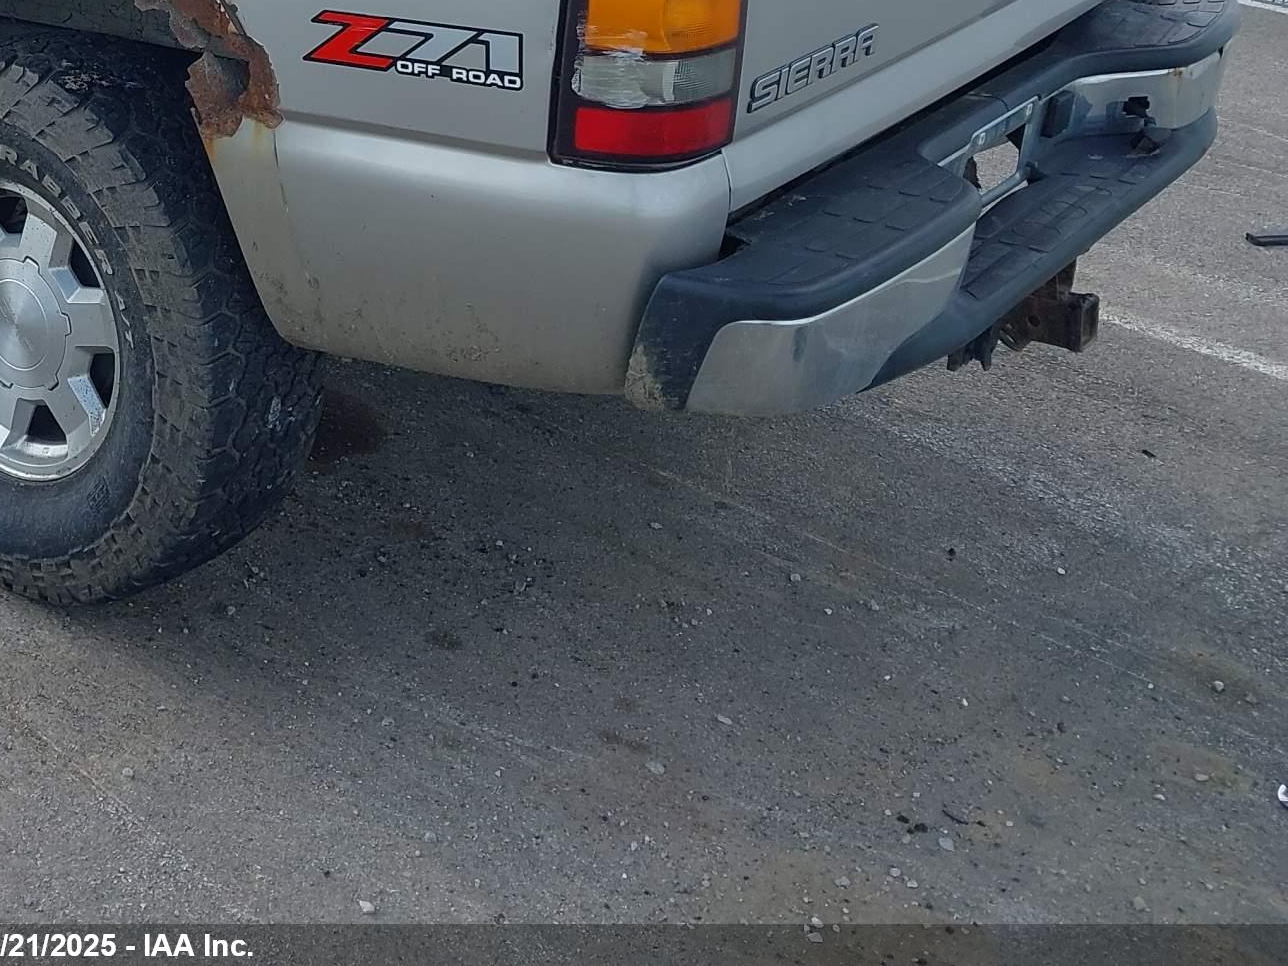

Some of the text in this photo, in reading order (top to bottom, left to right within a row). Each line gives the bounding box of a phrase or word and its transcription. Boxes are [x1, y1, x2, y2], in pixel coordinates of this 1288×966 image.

[303, 10, 523, 77] Z71
[395, 60, 523, 90] OFF ROAD
[747, 23, 880, 113] SIERRA
